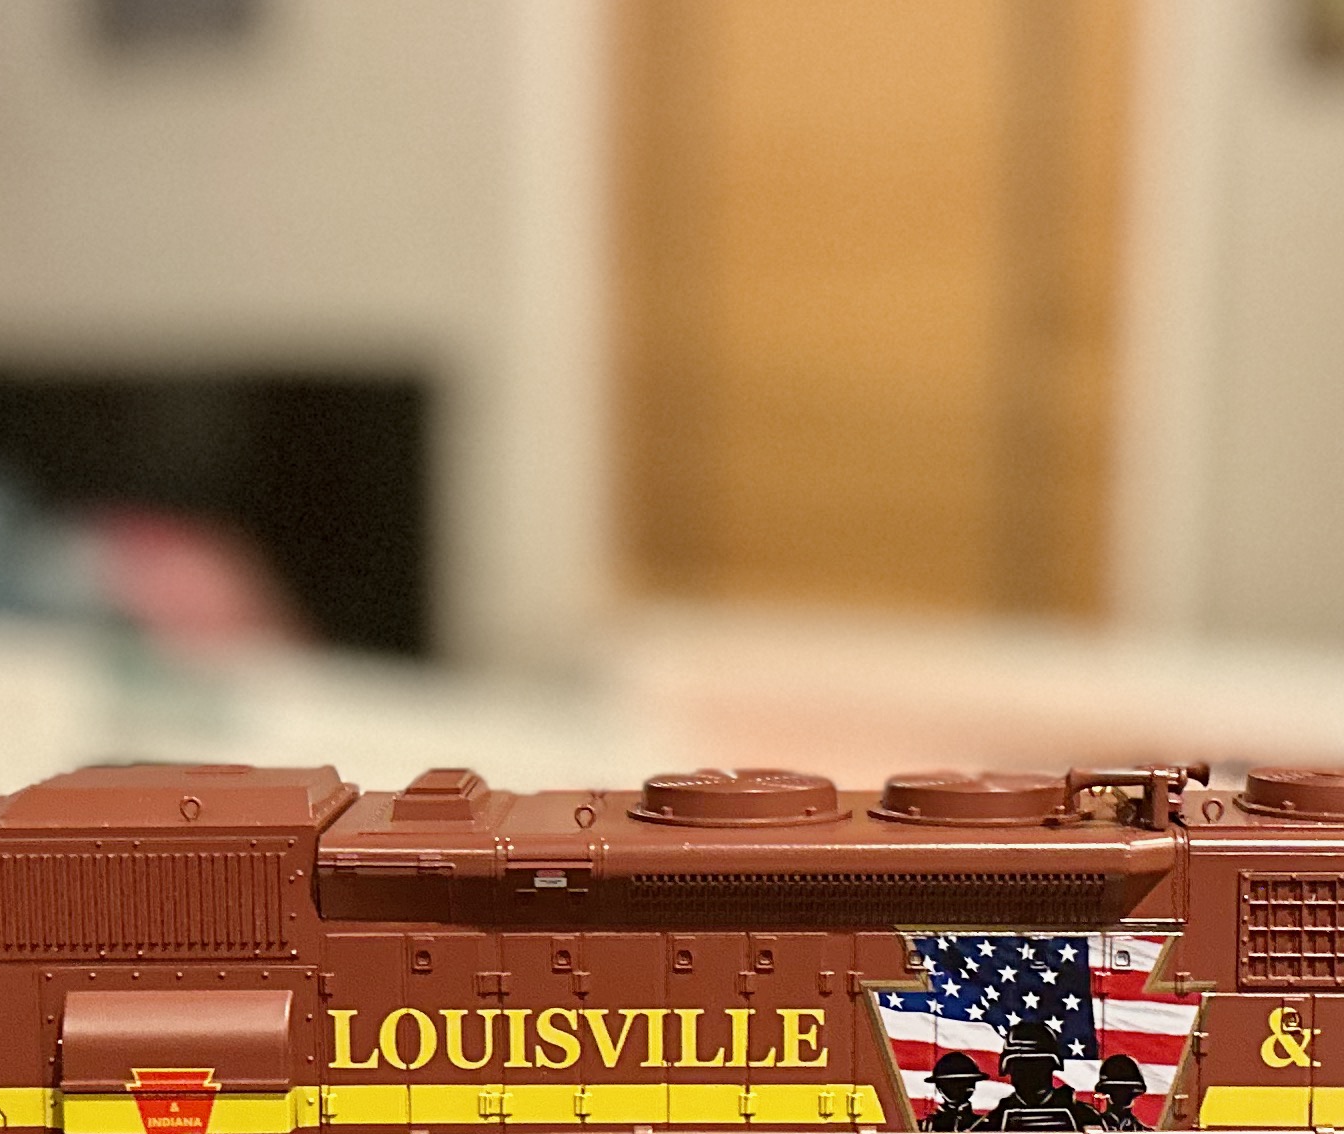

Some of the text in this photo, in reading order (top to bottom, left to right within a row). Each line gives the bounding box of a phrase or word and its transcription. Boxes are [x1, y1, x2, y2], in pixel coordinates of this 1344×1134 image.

[327, 1007, 829, 1070] LOUISVILLE
[1260, 1006, 1322, 1069] &
[147, 1117, 203, 1128] INDIANA
